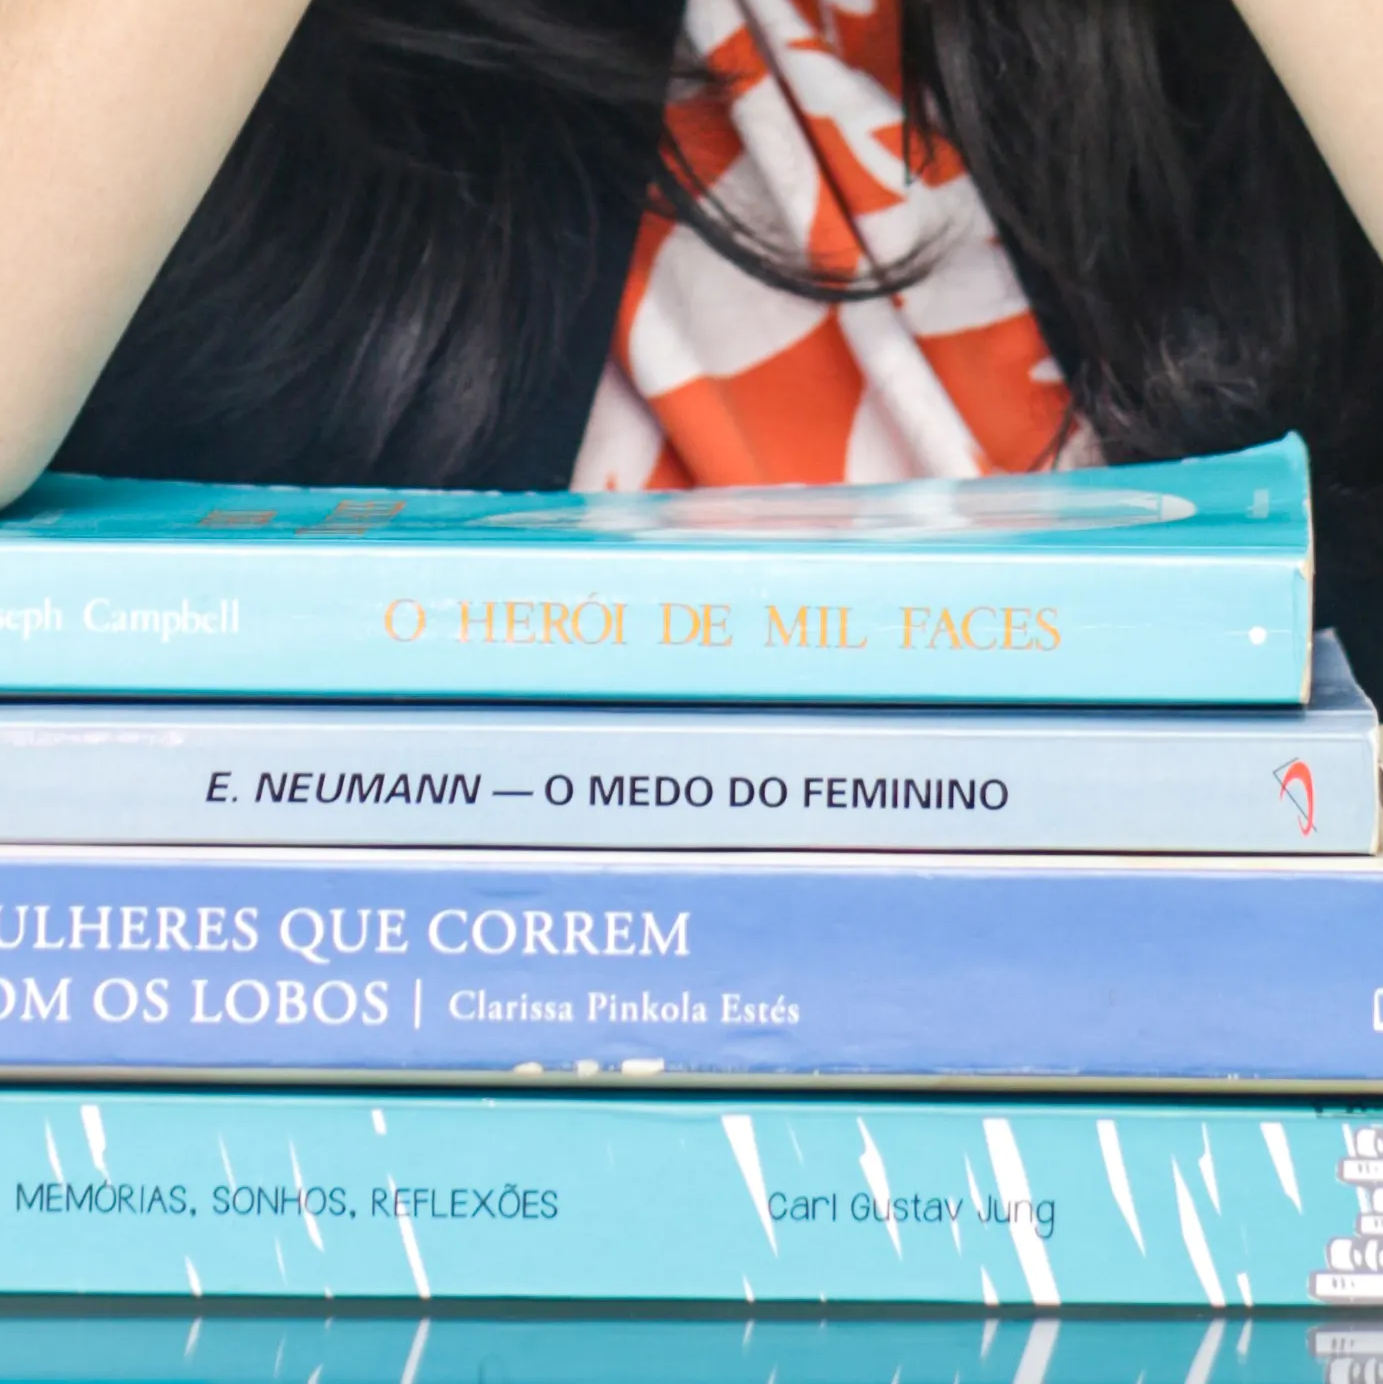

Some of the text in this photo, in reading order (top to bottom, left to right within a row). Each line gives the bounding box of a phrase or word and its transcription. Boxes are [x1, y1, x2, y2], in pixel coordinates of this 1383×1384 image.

[82, 597, 240, 643] Campbell
[384, 591, 1062, 651] O HERÓI DE MIL FACES
[205, 771, 239, 803] E.
[254, 772, 482, 806] NEUMANN
[544, 774, 574, 806] O
[589, 775, 714, 808] MEDO
[729, 776, 788, 808] DO
[803, 777, 1009, 810] FEMININO
[279, 908, 409, 965] QUE
[428, 909, 691, 956] CORREM
[93, 978, 169, 1023] OS
[189, 979, 389, 1026] LOBOS
[449, 990, 574, 1022] Clarissa
[587, 991, 707, 1024] Pinkola
[720, 993, 800, 1025] Estés
[16, 1180, 559, 1219] MEMÓRIAS, SONHOS, REFLEXÕES
[768, 1192, 1056, 1239] Carl Gustav Jung
